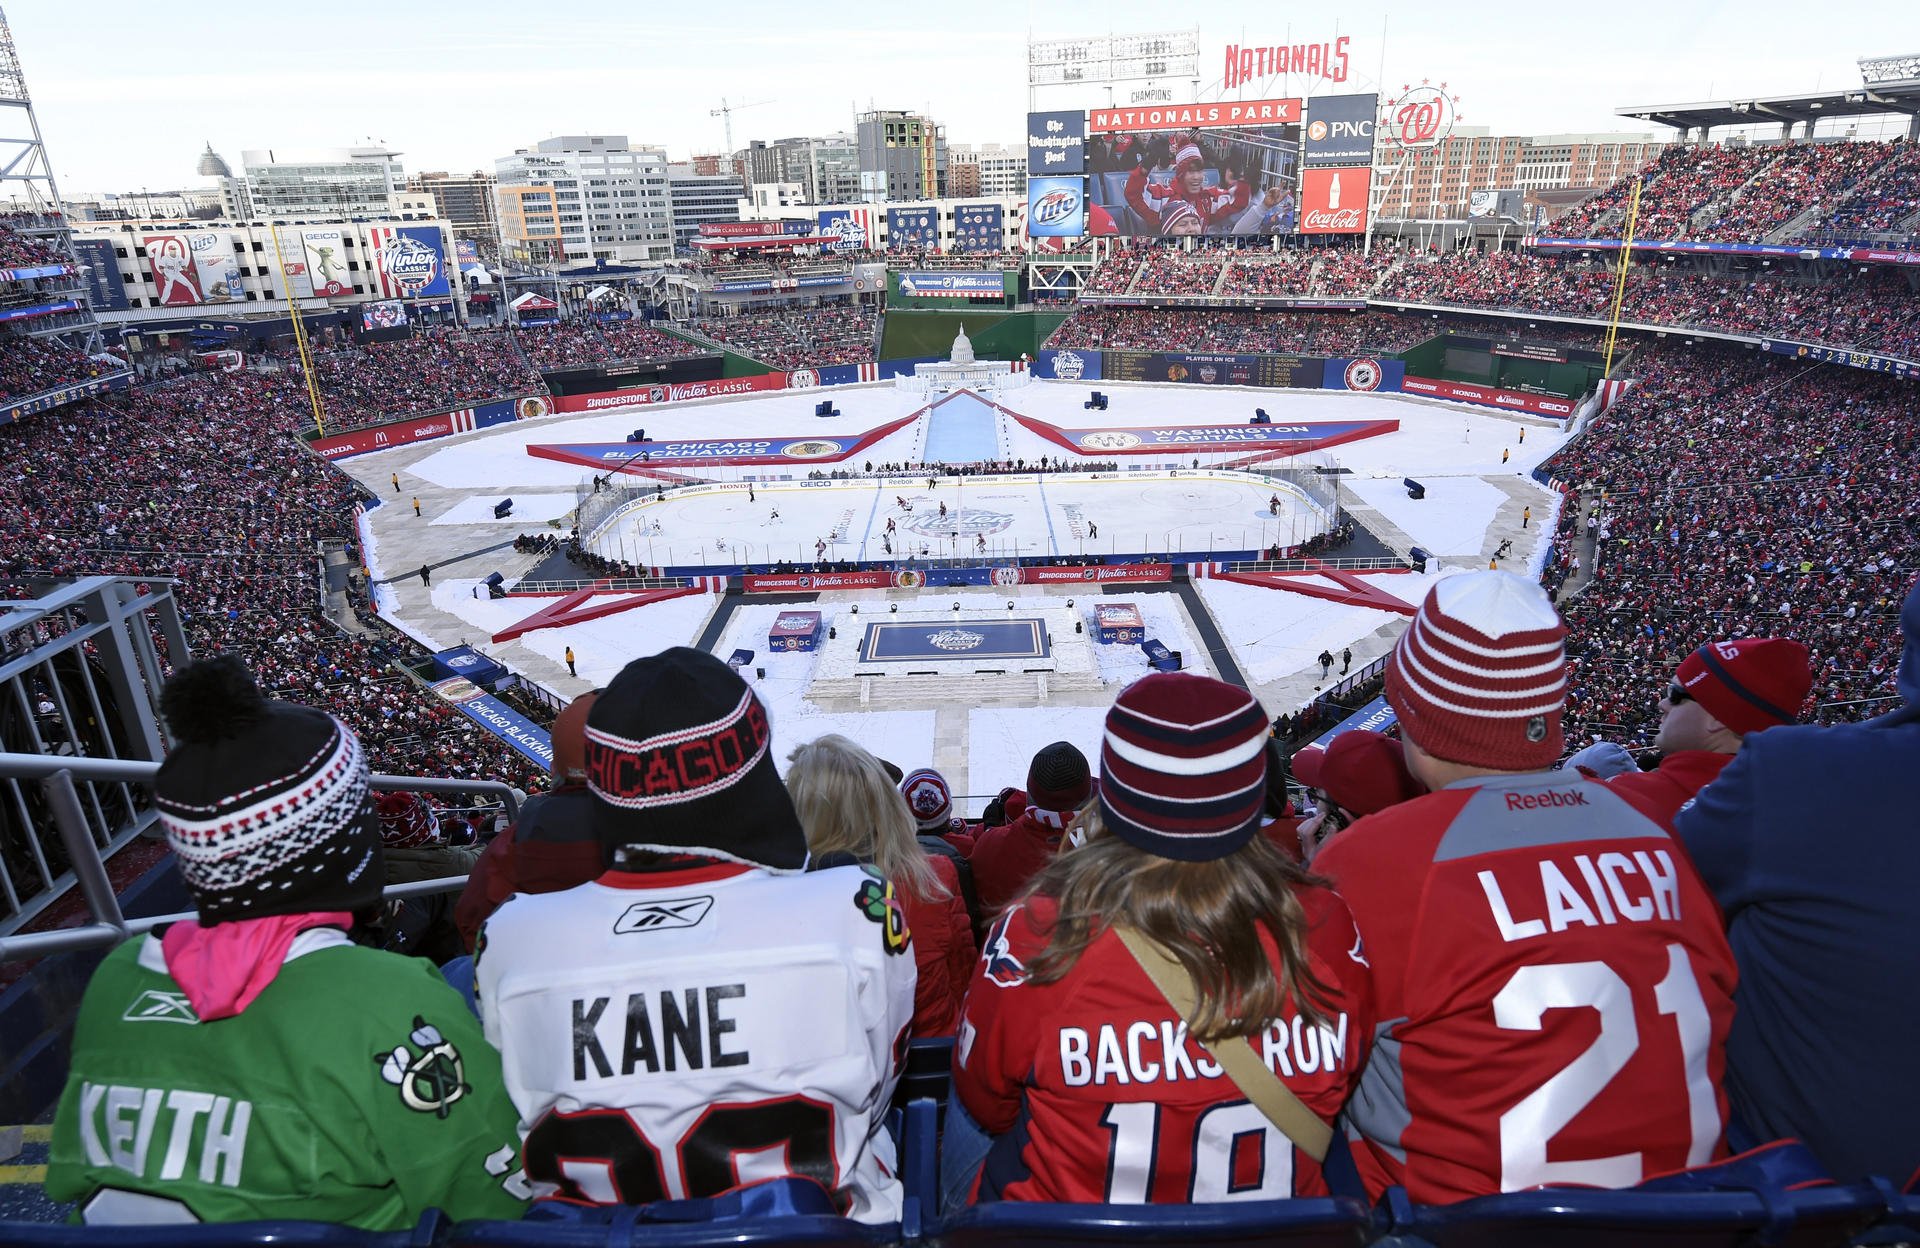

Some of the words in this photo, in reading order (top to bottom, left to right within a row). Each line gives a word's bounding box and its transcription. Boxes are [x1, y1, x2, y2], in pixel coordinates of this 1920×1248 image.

[1225, 36, 1349, 89] NATIONALS
[1131, 89, 1172, 103] CHAMPIONS
[1097, 108, 1219, 127] NATIONALS
[1231, 104, 1289, 120] PARK
[1047, 120, 1064, 132] The
[1331, 121, 1373, 138] PNC
[1028, 135, 1082, 149] Washington
[1045, 151, 1066, 165] Post
[305, 232, 339, 241] GEICO
[822, 227, 867, 248] Winter
[374, 246, 438, 274] Winter
[395, 265, 428, 273] CLASSIC
[950, 276, 977, 289] Winter
[1185, 355, 1212, 363] PLAYERS
[1827, 351, 1833, 360] 2
[1850, 353, 1869, 364] 15:32
[1052, 357, 1085, 370] Winter
[1885, 361, 1891, 371] 2
[1230, 372, 1251, 380] CAPITALS
[1405, 380, 1437, 392] BRIDGESTONE
[586, 393, 648, 408] BRIDGESTONE
[664, 383, 709, 402] Winter
[710, 382, 753, 394] CLASSIC
[1452, 389, 1482, 399] HONDA
[1539, 401, 1569, 413] GEICO
[1151, 426, 1309, 437] WASHINGTON
[1155, 433, 1268, 442] CAPITALS
[319, 444, 355, 457] ONDA
[665, 441, 772, 451] CHICAGO
[631, 495, 656, 509] DISCOVER
[1095, 567, 1127, 580] Winter
[1129, 568, 1162, 577] CLASSIC
[811, 575, 842, 589] Winter
[844, 576, 877, 585] CLASSIC
[468, 700, 512, 728] CHICAGO
[1505, 789, 1590, 811] Reebok
[1477, 850, 1681, 942] LAICH
[572, 984, 749, 1081] KANE
[1059, 1012, 1348, 1087] BACKSROM
[1493, 942, 1722, 1193] 21
[80, 1081, 253, 1188] KEITH
